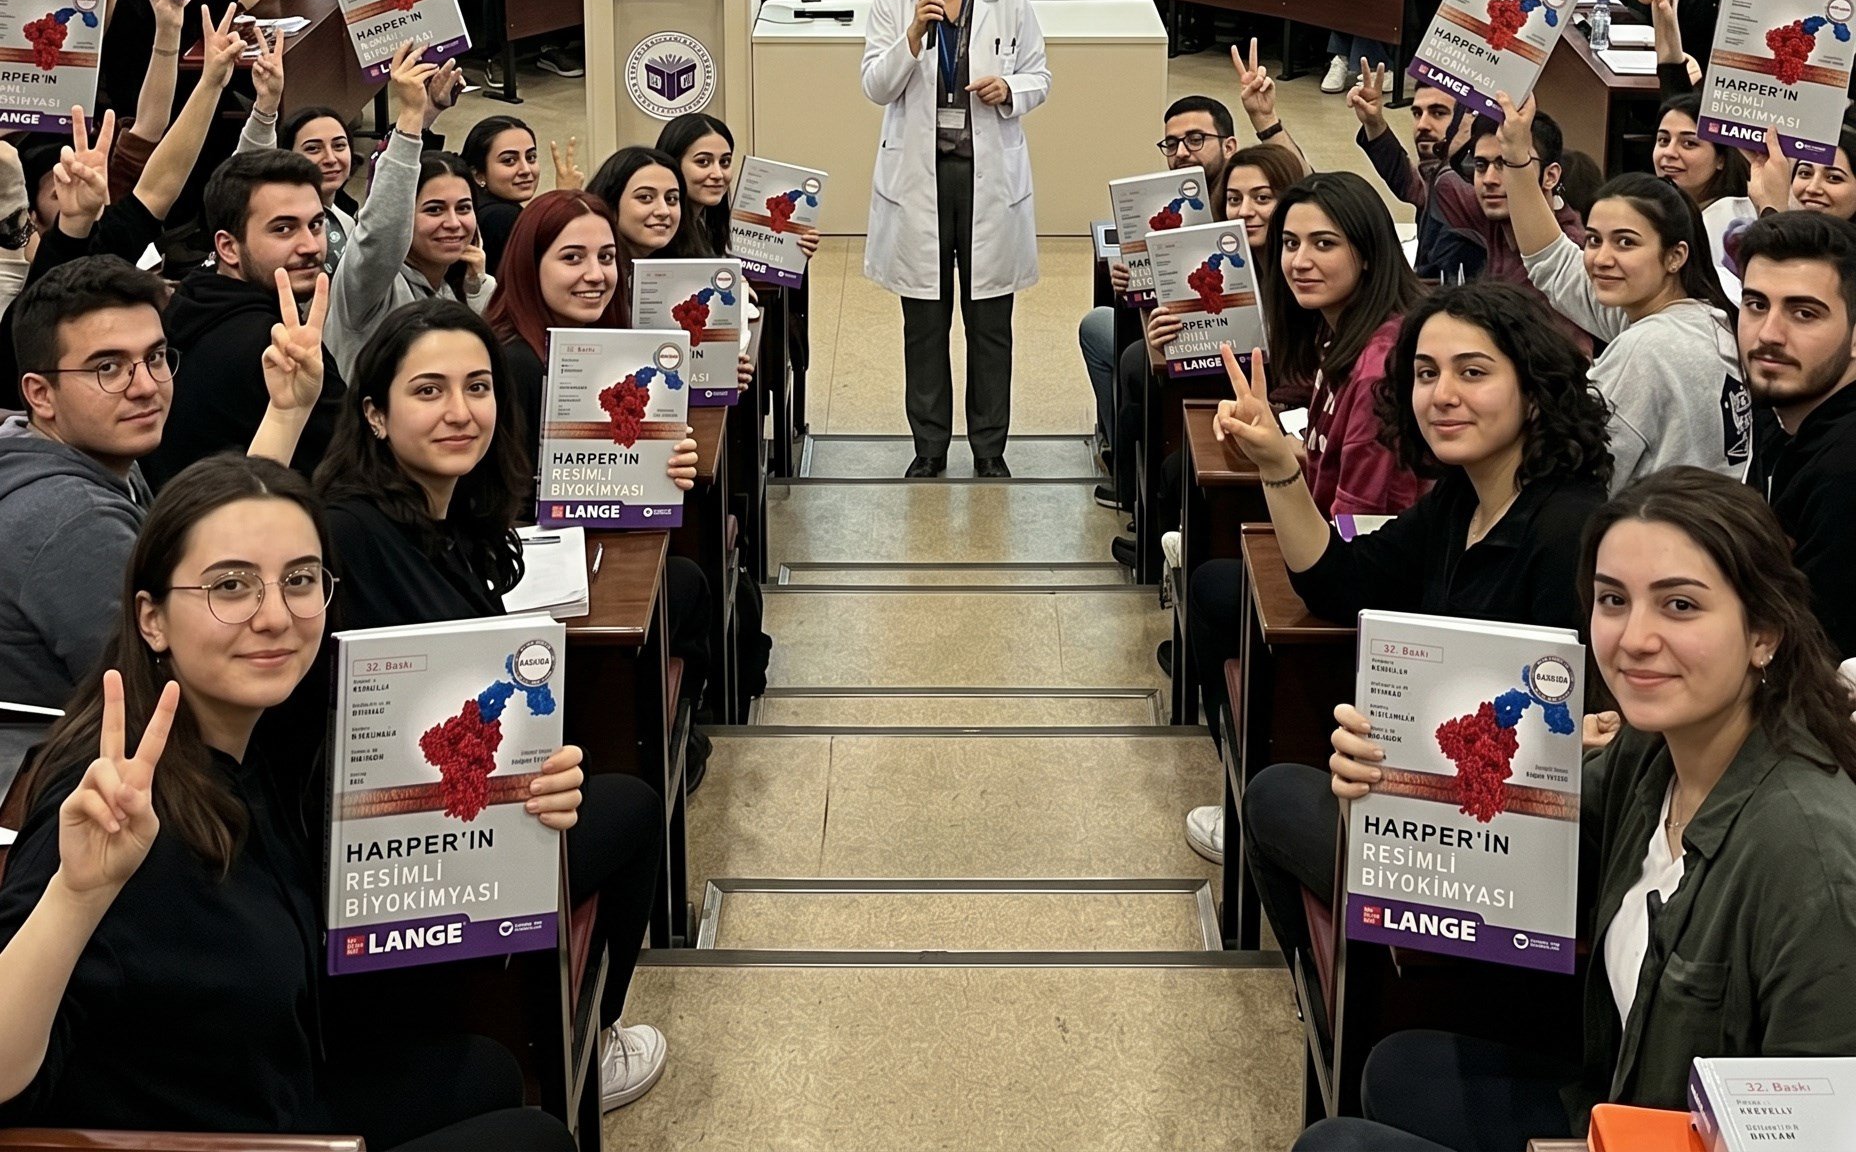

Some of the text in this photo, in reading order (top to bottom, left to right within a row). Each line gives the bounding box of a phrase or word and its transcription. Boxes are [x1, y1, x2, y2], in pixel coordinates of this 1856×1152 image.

[1, 71, 58, 84] RPER'IN
[1427, 68, 1471, 97] LANGE
[1715, 76, 1799, 101] HARPER'IN
[0, 112, 41, 125] ANGE
[1182, 317, 1229, 331] RPER'IN
[1183, 357, 1223, 371] LANGE
[553, 452, 640, 465] HARPER'IN
[565, 505, 620, 519] LANGE
[346, 828, 494, 864] HARPER'IN
[1364, 815, 1510, 855] HARPER'İN
[1363, 842, 1456, 874] RESİMLİ
[346, 859, 442, 892] RESİMLİ
[1361, 865, 1514, 909] BİYOKİMYASI
[345, 881, 499, 918] BİYOKİMYASI
[368, 922, 463, 955] LANGE
[1383, 907, 1477, 942] LANGE
[1745, 1082, 1769, 1093] 32.
